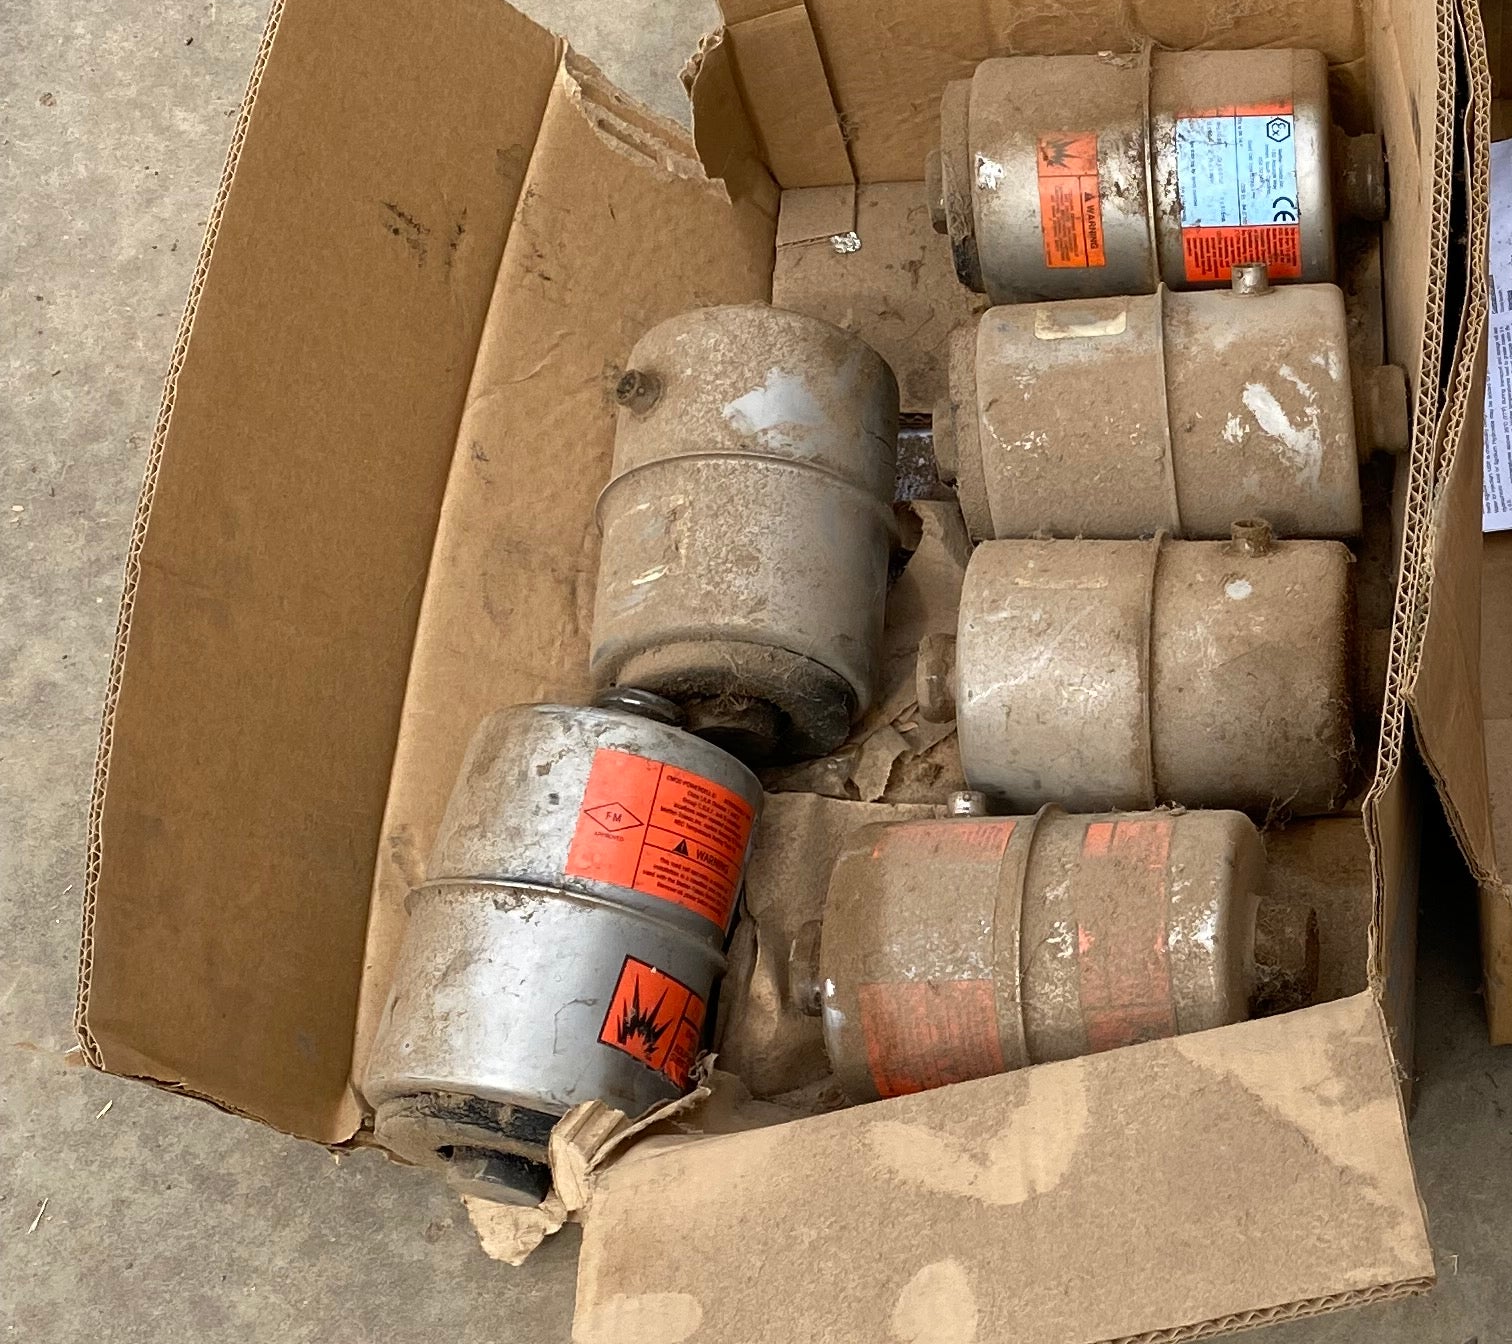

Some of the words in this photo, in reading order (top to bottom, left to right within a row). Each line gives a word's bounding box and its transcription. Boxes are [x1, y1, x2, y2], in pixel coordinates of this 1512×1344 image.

[1273, 197, 1295, 222] CE
[1087, 205, 1098, 249] WARNING
[696, 849, 729, 874] WARNING
